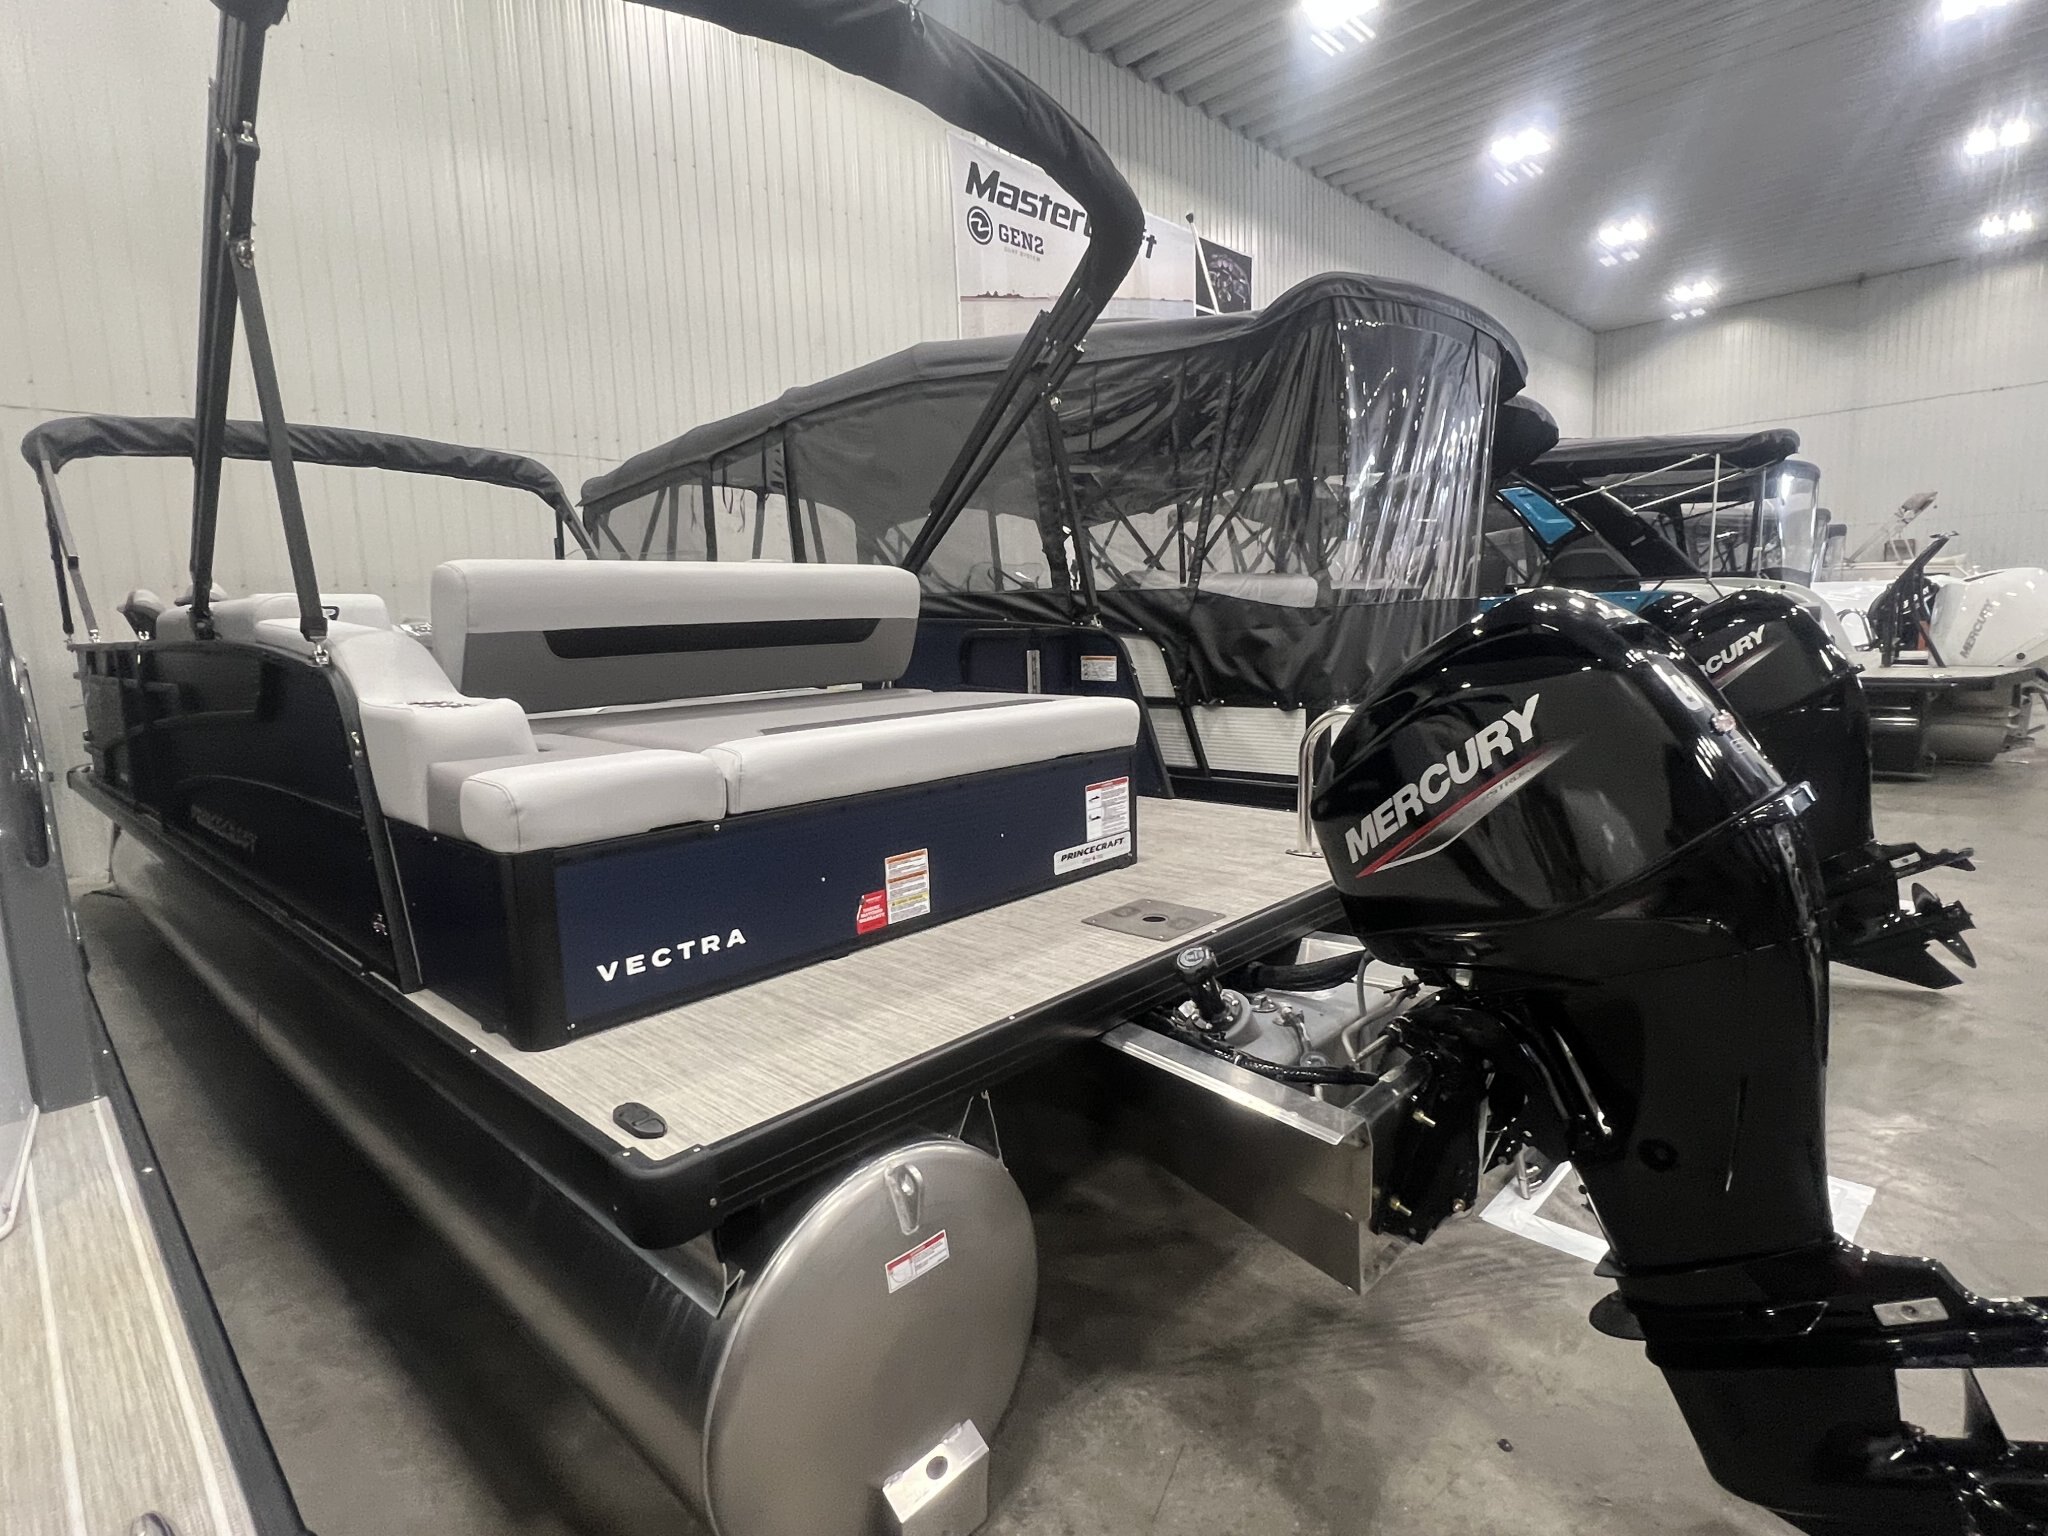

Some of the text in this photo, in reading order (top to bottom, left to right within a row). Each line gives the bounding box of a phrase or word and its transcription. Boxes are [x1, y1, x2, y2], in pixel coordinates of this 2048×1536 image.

[965, 161, 1157, 259] Mastert
[998, 223, 1044, 255] GEN2
[1699, 624, 1765, 677] CURY
[1345, 693, 1540, 864] MERCURY
[1060, 837, 1125, 862] PRINCECRAFT
[596, 928, 747, 982] VECTRA
